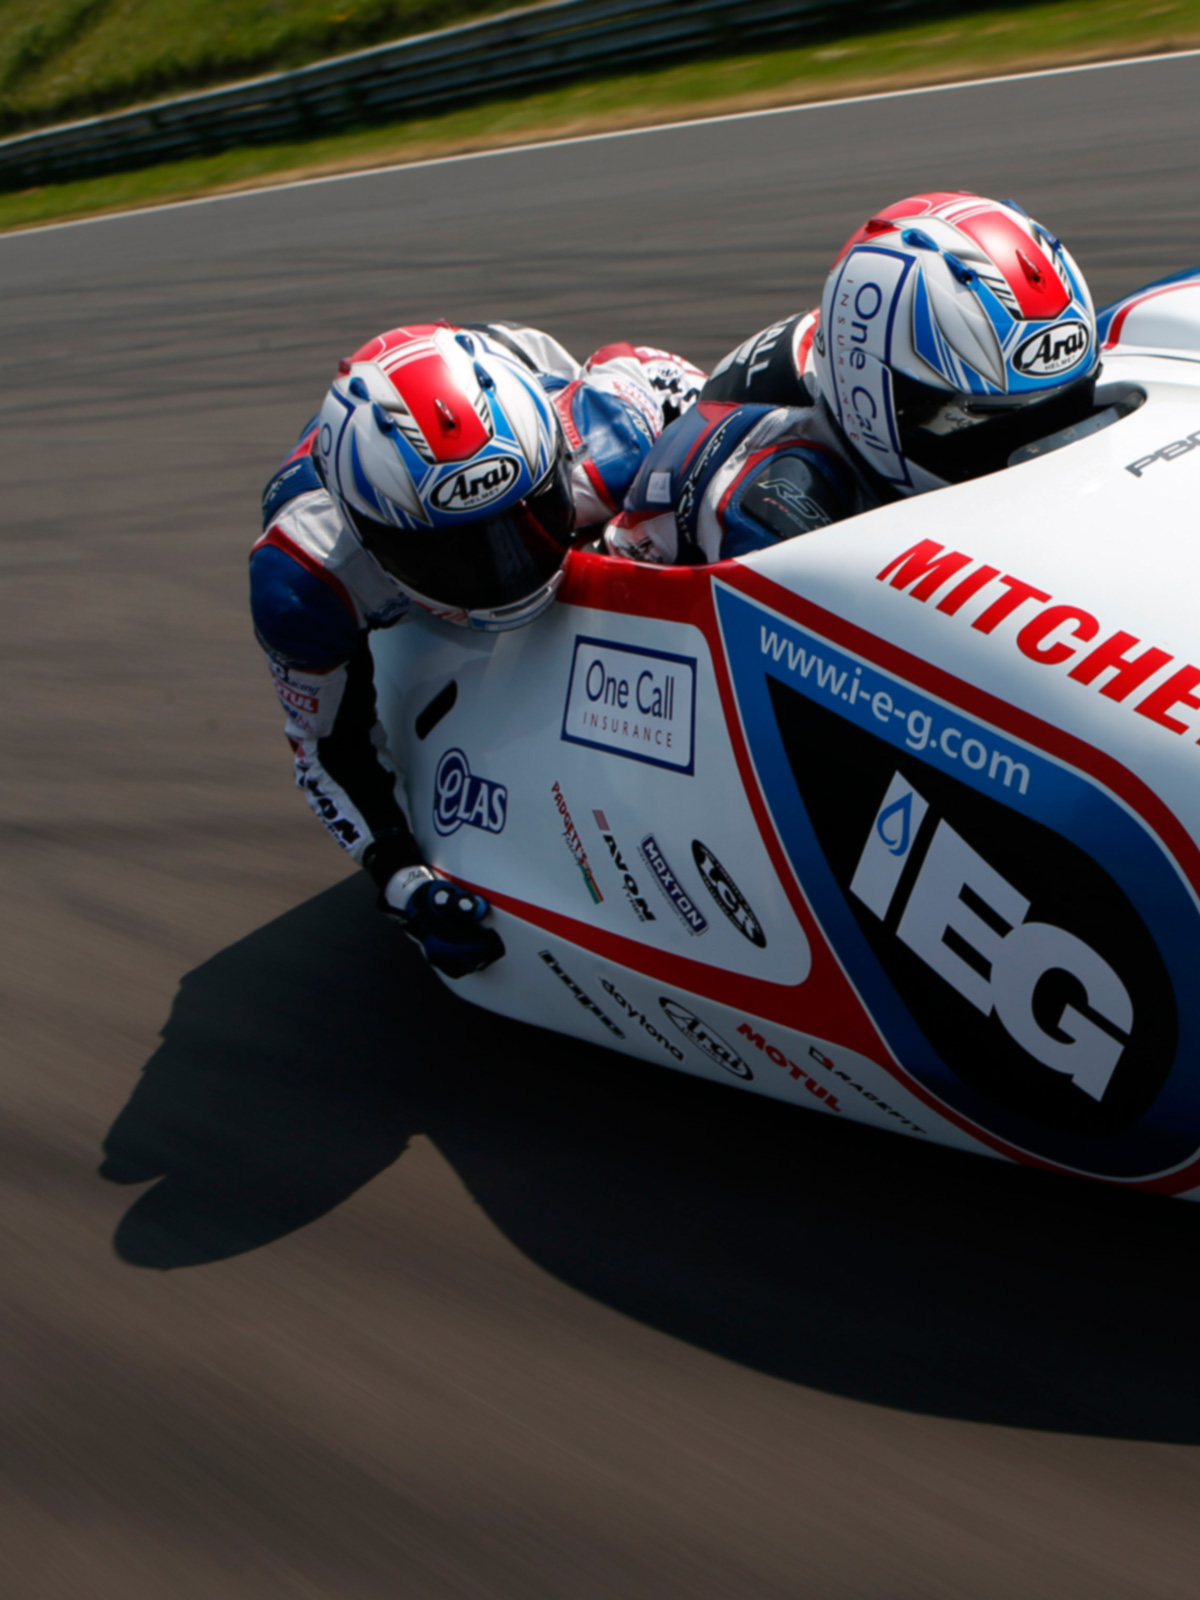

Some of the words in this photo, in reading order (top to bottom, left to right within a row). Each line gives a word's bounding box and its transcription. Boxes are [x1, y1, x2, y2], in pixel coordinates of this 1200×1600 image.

[849, 281, 883, 371] One
[1032, 324, 1085, 366] Arai
[852, 385, 890, 455] Call
[440, 459, 511, 508] Arai
[583, 710, 674, 749] INSURANCE
[584, 658, 630, 709] One
[635, 669, 676, 723] Call
[760, 624, 1032, 795] www.i-e-g.com
[550, 780, 589, 864] PADGETT'S
[602, 834, 656, 921] AVON
[643, 841, 703, 930] MAXTON
[699, 856, 758, 941] LCR
[849, 769, 1134, 1102] IEG
[599, 976, 685, 1062] daytona
[671, 1006, 747, 1074] Arai
[736, 1022, 842, 1113] MOTUL
